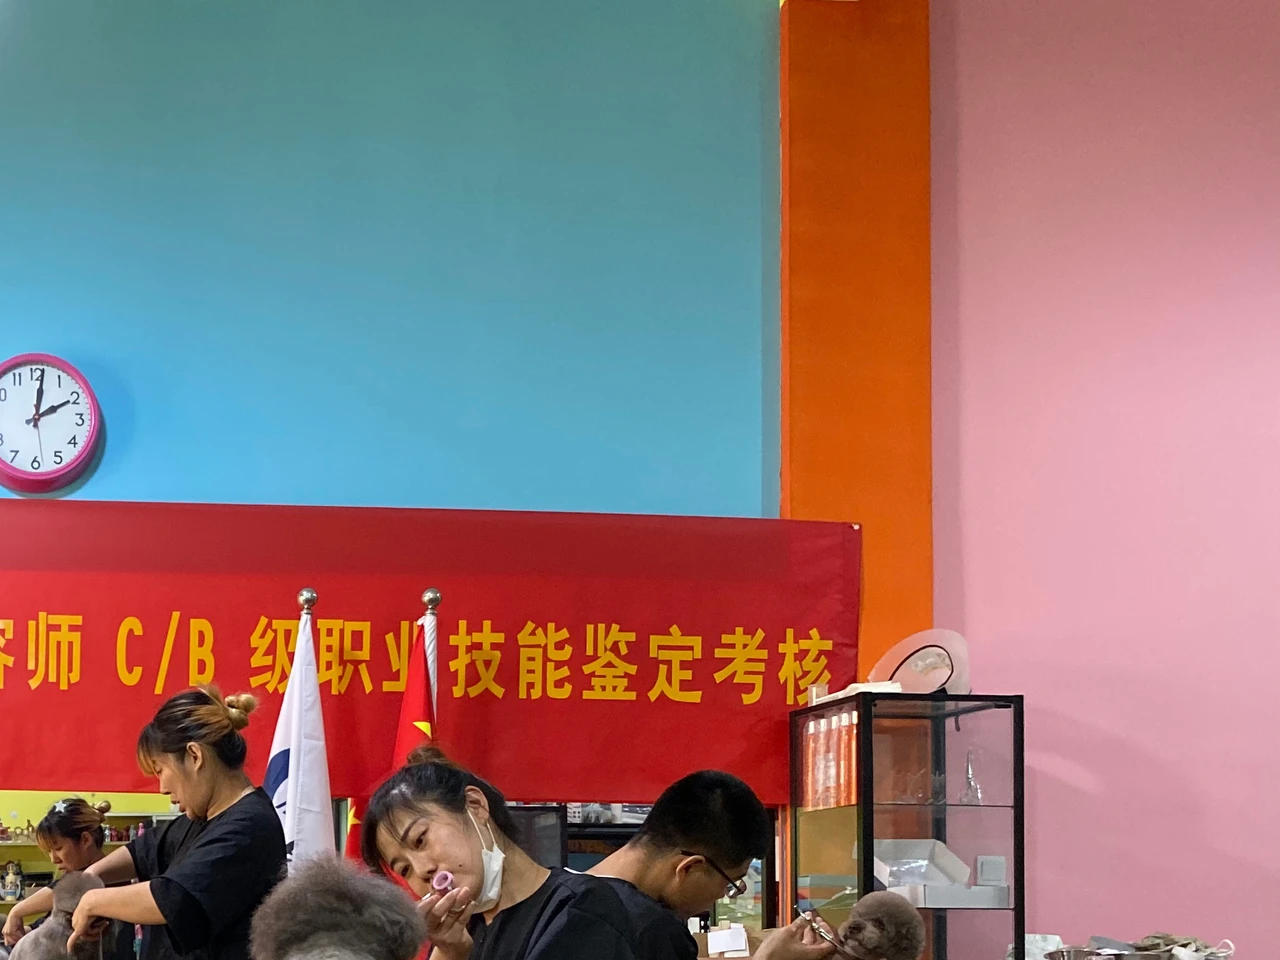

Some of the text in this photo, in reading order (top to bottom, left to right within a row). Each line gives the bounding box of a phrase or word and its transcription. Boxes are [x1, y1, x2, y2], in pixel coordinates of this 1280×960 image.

[13, 372, 22, 386] 11
[30, 368, 43, 381] 12
[70, 391, 80, 405] 2
[75, 413, 85, 427] 3
[67, 434, 78, 448] 4
[10, 450, 20, 464] 7
[31, 456, 41, 470] 6
[53, 451, 63, 465] 5
[116, 611, 215, 696] C/B
